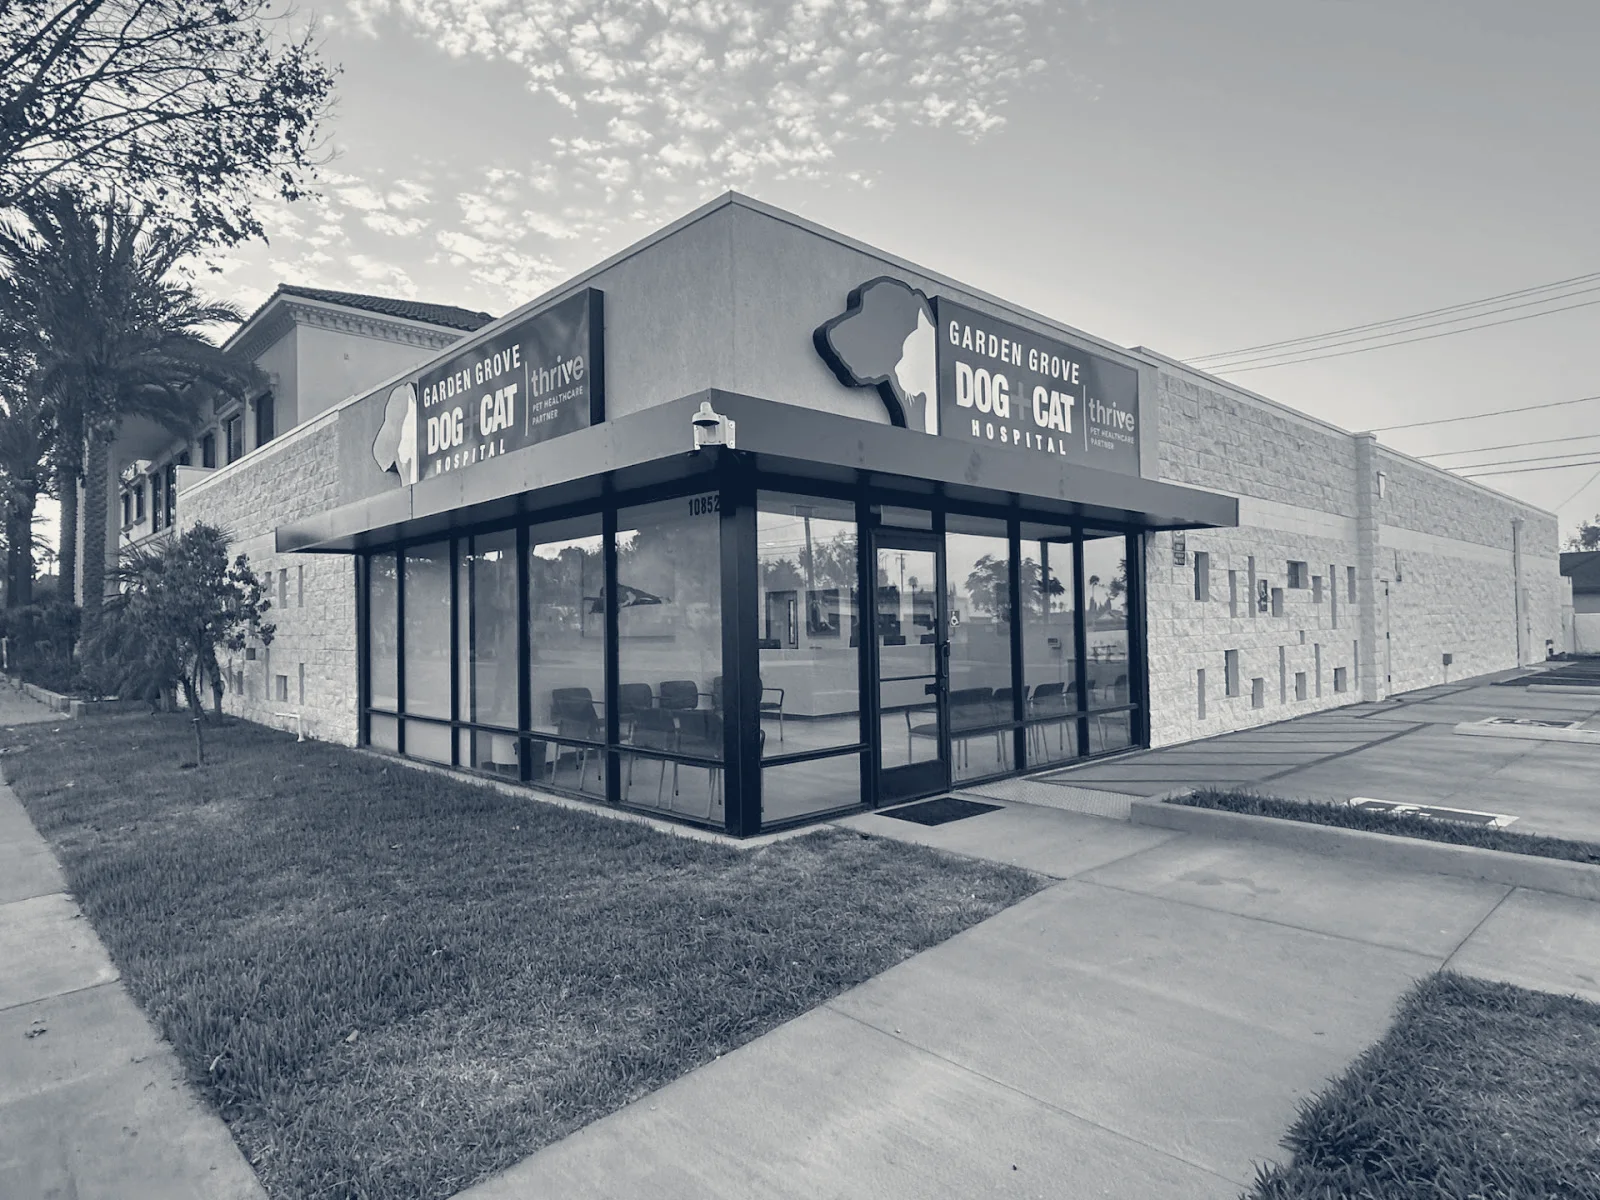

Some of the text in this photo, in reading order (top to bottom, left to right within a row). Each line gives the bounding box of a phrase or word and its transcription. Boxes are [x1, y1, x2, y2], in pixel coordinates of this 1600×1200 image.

[949, 320, 1080, 385] GARDEN GROVE
[423, 343, 521, 408] GARDEN GROVE
[531, 354, 584, 397] thrive
[532, 385, 584, 412] PET HEALTHCARE
[955, 360, 1010, 419] DOG
[1032, 385, 1075, 434] CAT
[1088, 398, 1135, 432] thrive
[427, 406, 464, 455] DOG
[479, 383, 518, 436] CAT
[532, 409, 559, 425] PARTNER
[1090, 426, 1101, 435] PET
[971, 419, 1066, 456] HOSPITAL
[1090, 437, 1114, 450] PARTNER
[436, 438, 505, 475] HOSPITAL
[688, 494, 720, 516] 10852
